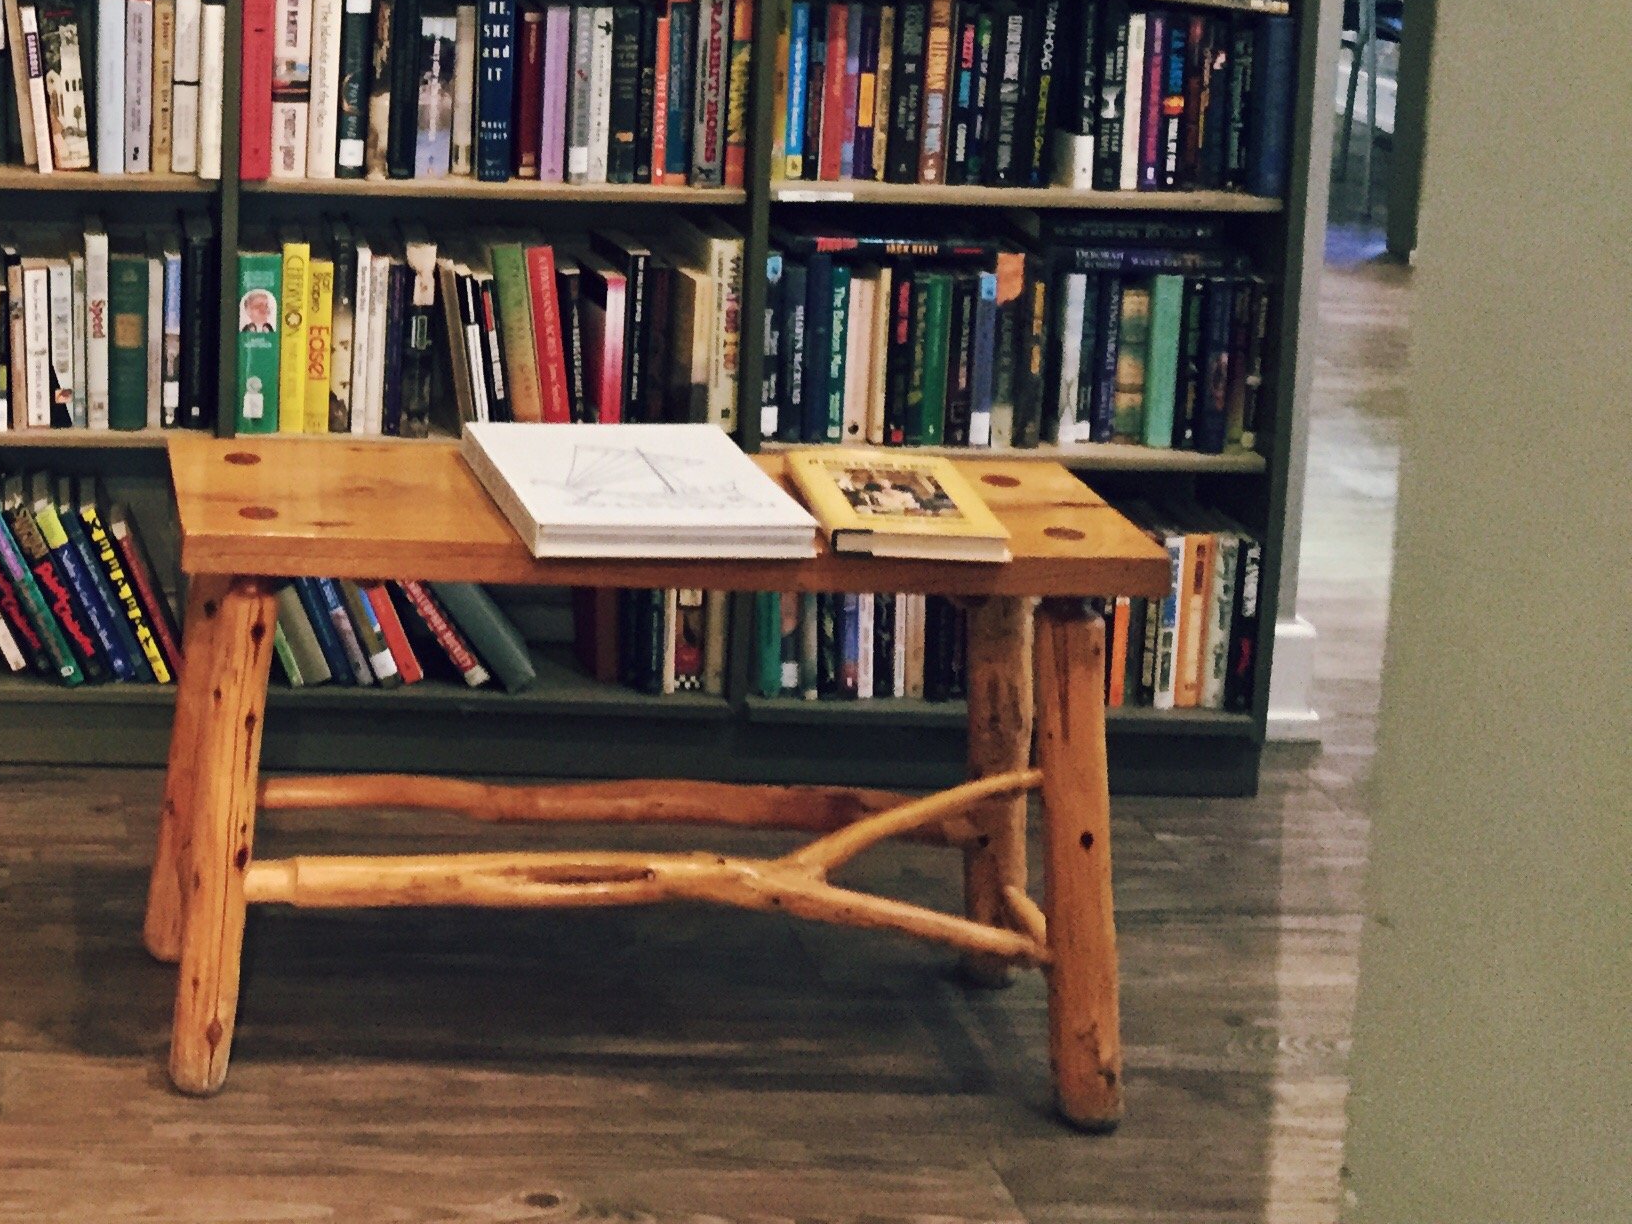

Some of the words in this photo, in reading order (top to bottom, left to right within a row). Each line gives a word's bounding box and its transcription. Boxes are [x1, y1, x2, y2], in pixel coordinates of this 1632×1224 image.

[482, 23, 510, 38] SHE
[1045, 1, 1059, 32] TAMI
[1117, 25, 1125, 42] THE
[27, 34, 40, 77] CARROLL
[482, 44, 510, 59] and
[708, 0, 724, 98] RABBIT
[1041, 32, 1055, 70] HOAG
[487, 67, 503, 82] IT
[656, 73, 666, 99] THE
[958, 71, 972, 108] MONEY
[1036, 75, 1050, 127] SECRETS
[654, 102, 666, 150] PRINCE
[704, 100, 719, 163] BOSS
[956, 123, 967, 162] CONDON
[1112, 123, 1120, 153] PETER
[311, 271, 322, 313] Shapiro
[323, 272, 331, 293] Karl
[834, 287, 846, 307] The
[89, 299, 106, 338] Speed
[793, 305, 804, 350] SHARYN
[831, 309, 844, 351] Balloon
[309, 325, 329, 381] Edsel
[830, 355, 843, 378] Man
[791, 352, 803, 404] McCRUMB
